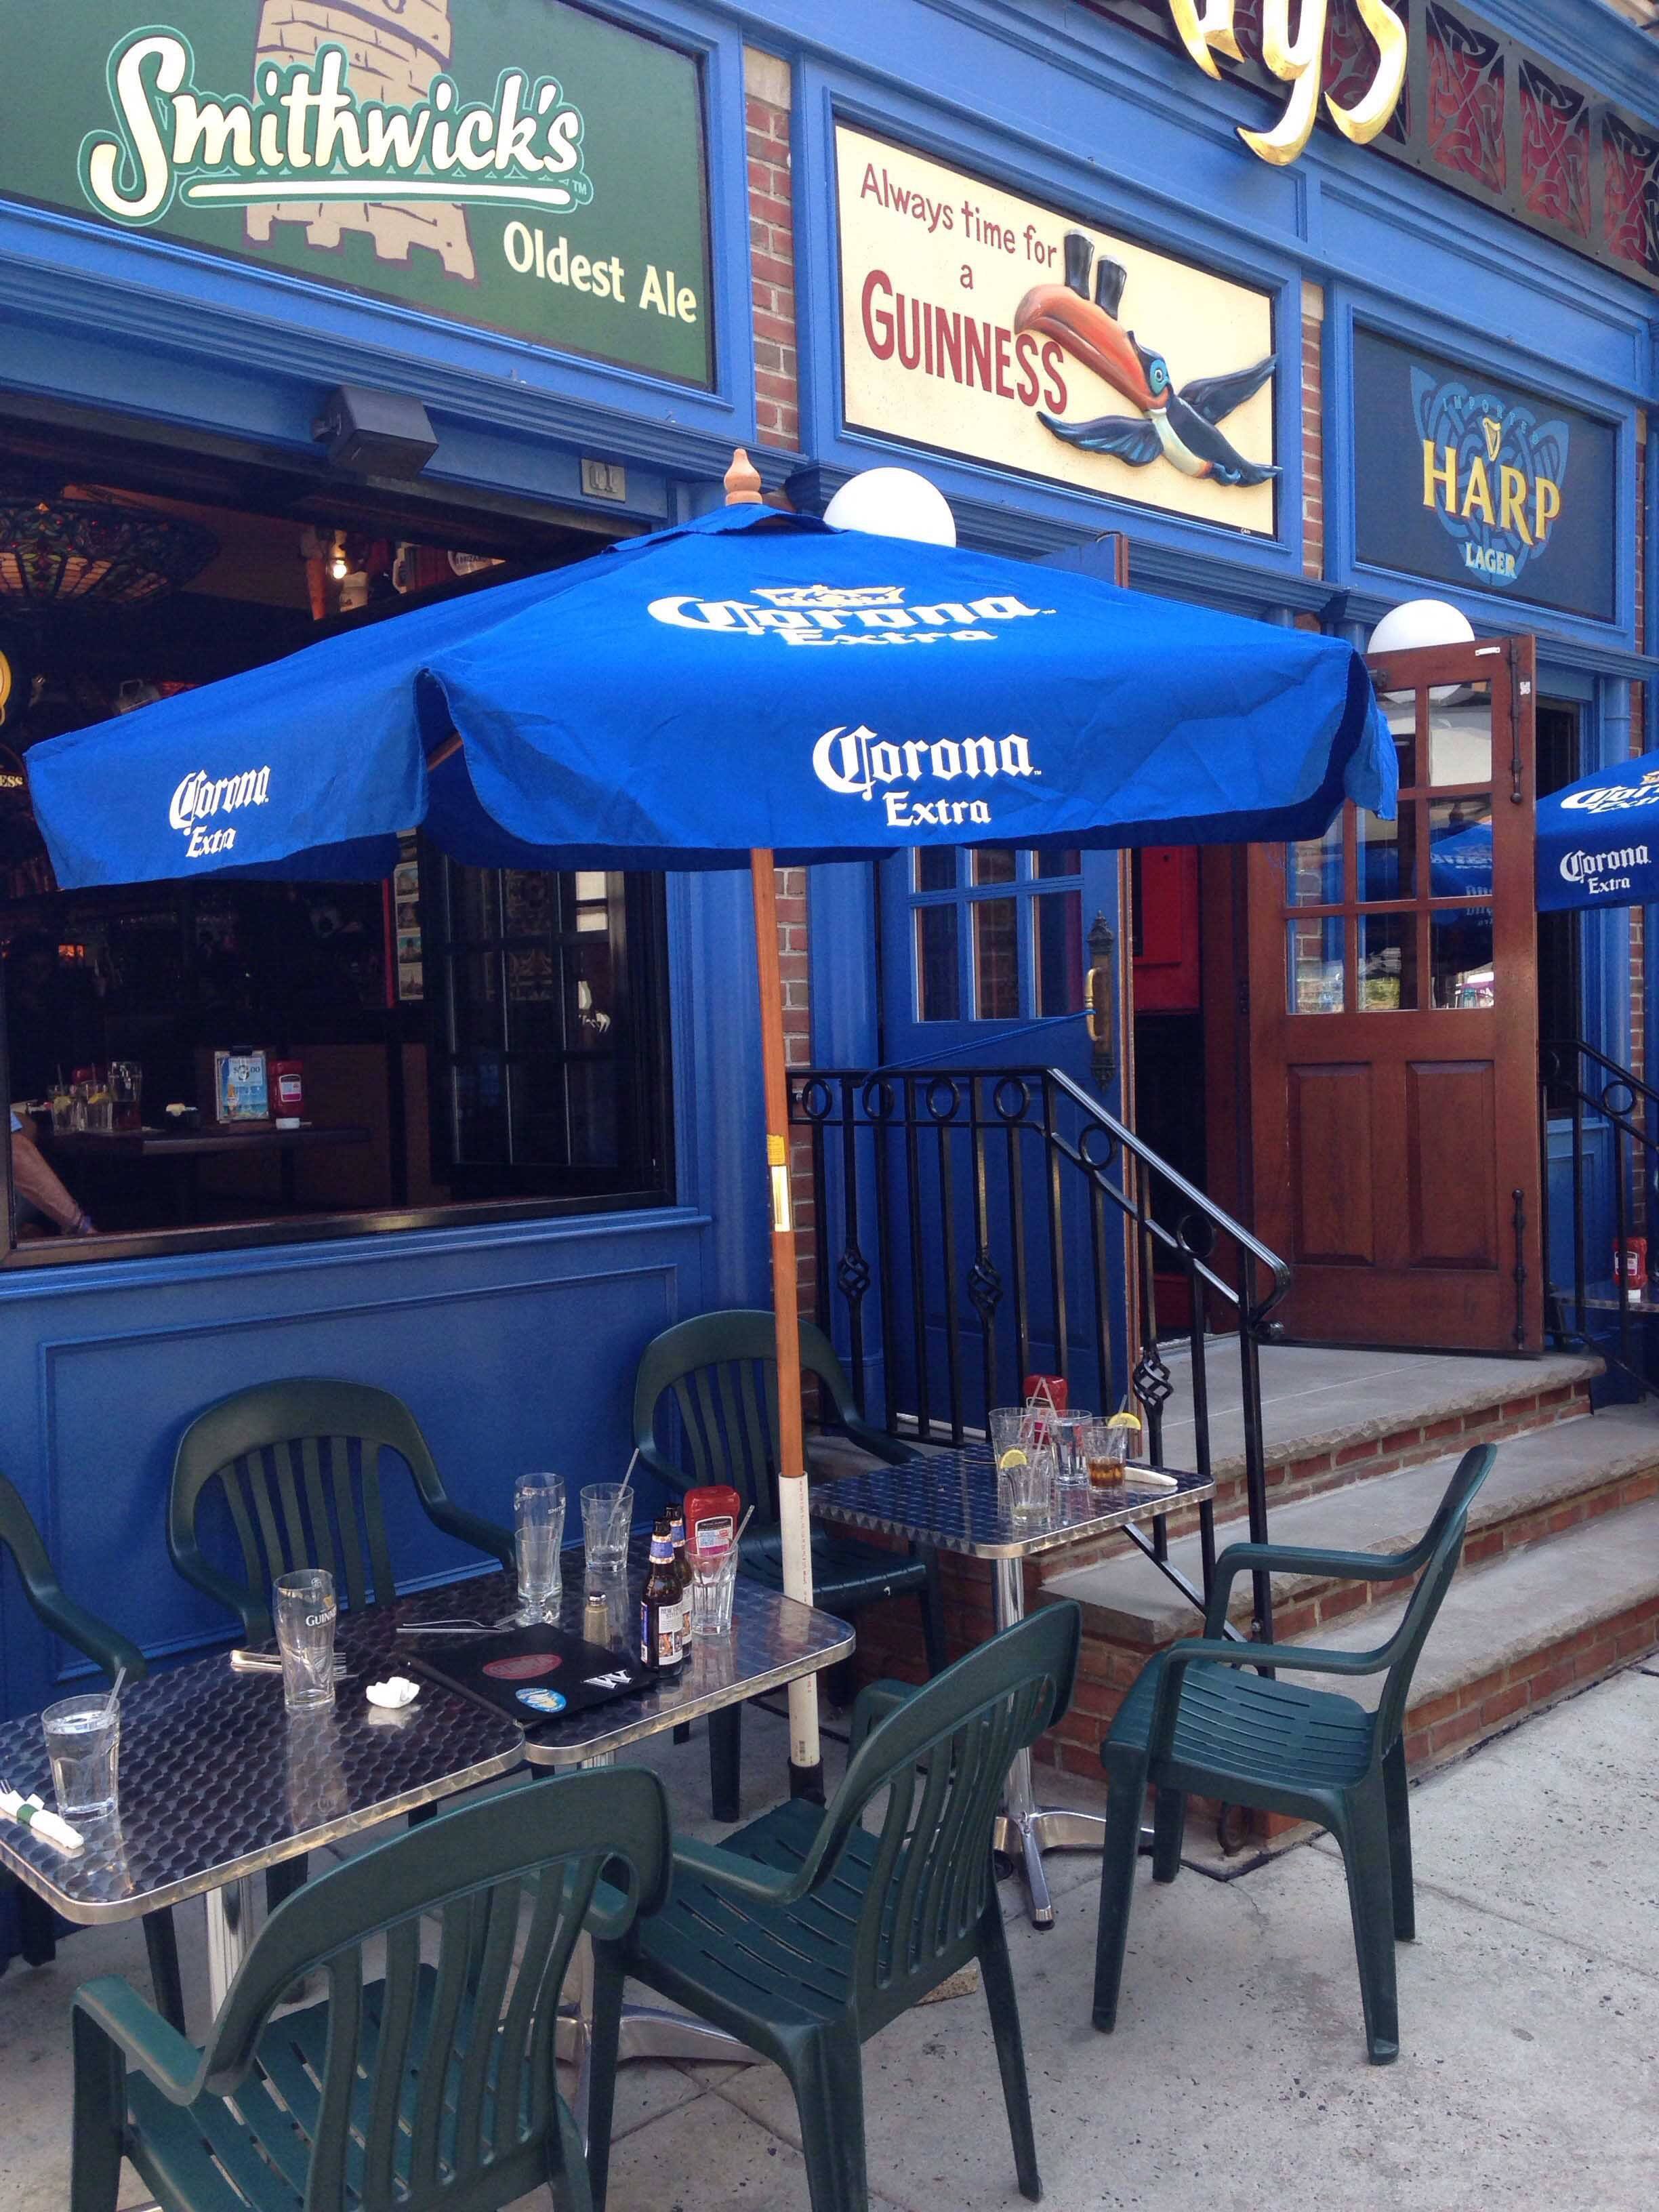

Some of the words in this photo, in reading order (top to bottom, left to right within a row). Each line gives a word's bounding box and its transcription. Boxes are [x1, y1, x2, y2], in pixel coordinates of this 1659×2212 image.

[90, 35, 578, 217] Smithwick's
[861, 163, 954, 234] Always
[961, 200, 1016, 254] time
[1023, 224, 1057, 268] for
[504, 221, 626, 303] Oldest
[639, 264, 697, 323] Ale
[960, 264, 974, 290] a
[861, 269, 1067, 415] GUINNESS
[1422, 438, 1561, 547] HARP
[1465, 541, 1518, 579] LAGER
[647, 596, 1041, 635] Corona
[773, 628, 998, 645] Extra
[813, 724, 1034, 802] Corona
[169, 764, 271, 836] Corona
[882, 791, 991, 826] Extra
[1559, 845, 1652, 884] Corona
[1587, 877, 1631, 895] Extra
